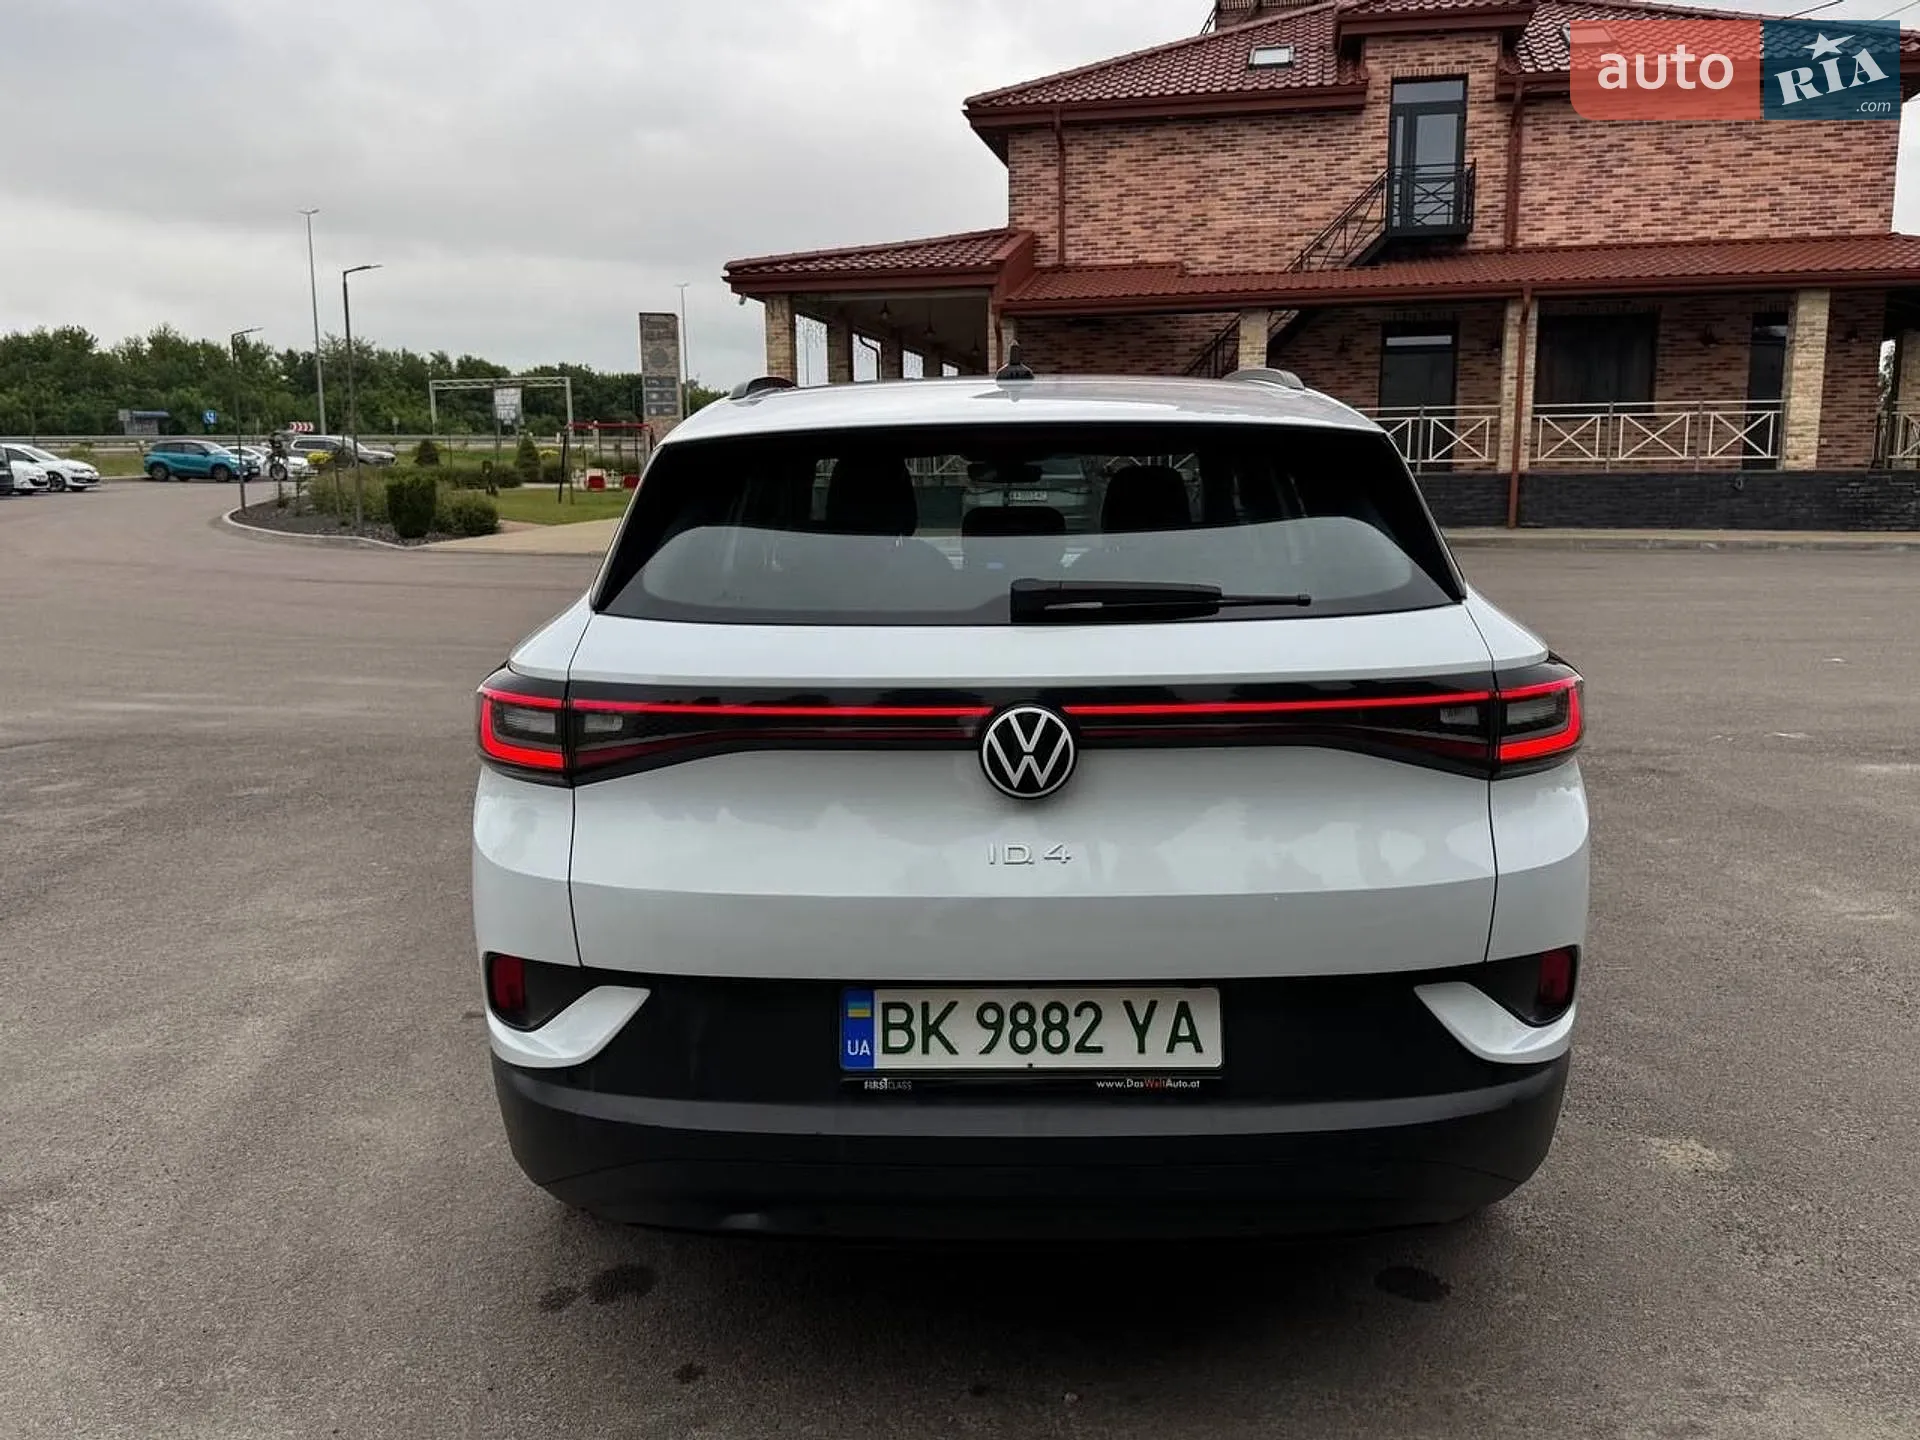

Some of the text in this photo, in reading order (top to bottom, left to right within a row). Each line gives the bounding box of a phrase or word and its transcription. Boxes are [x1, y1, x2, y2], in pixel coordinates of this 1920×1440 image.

[881, 999, 1204, 1055] BK 9882 YA
[847, 1039, 871, 1056] UA
